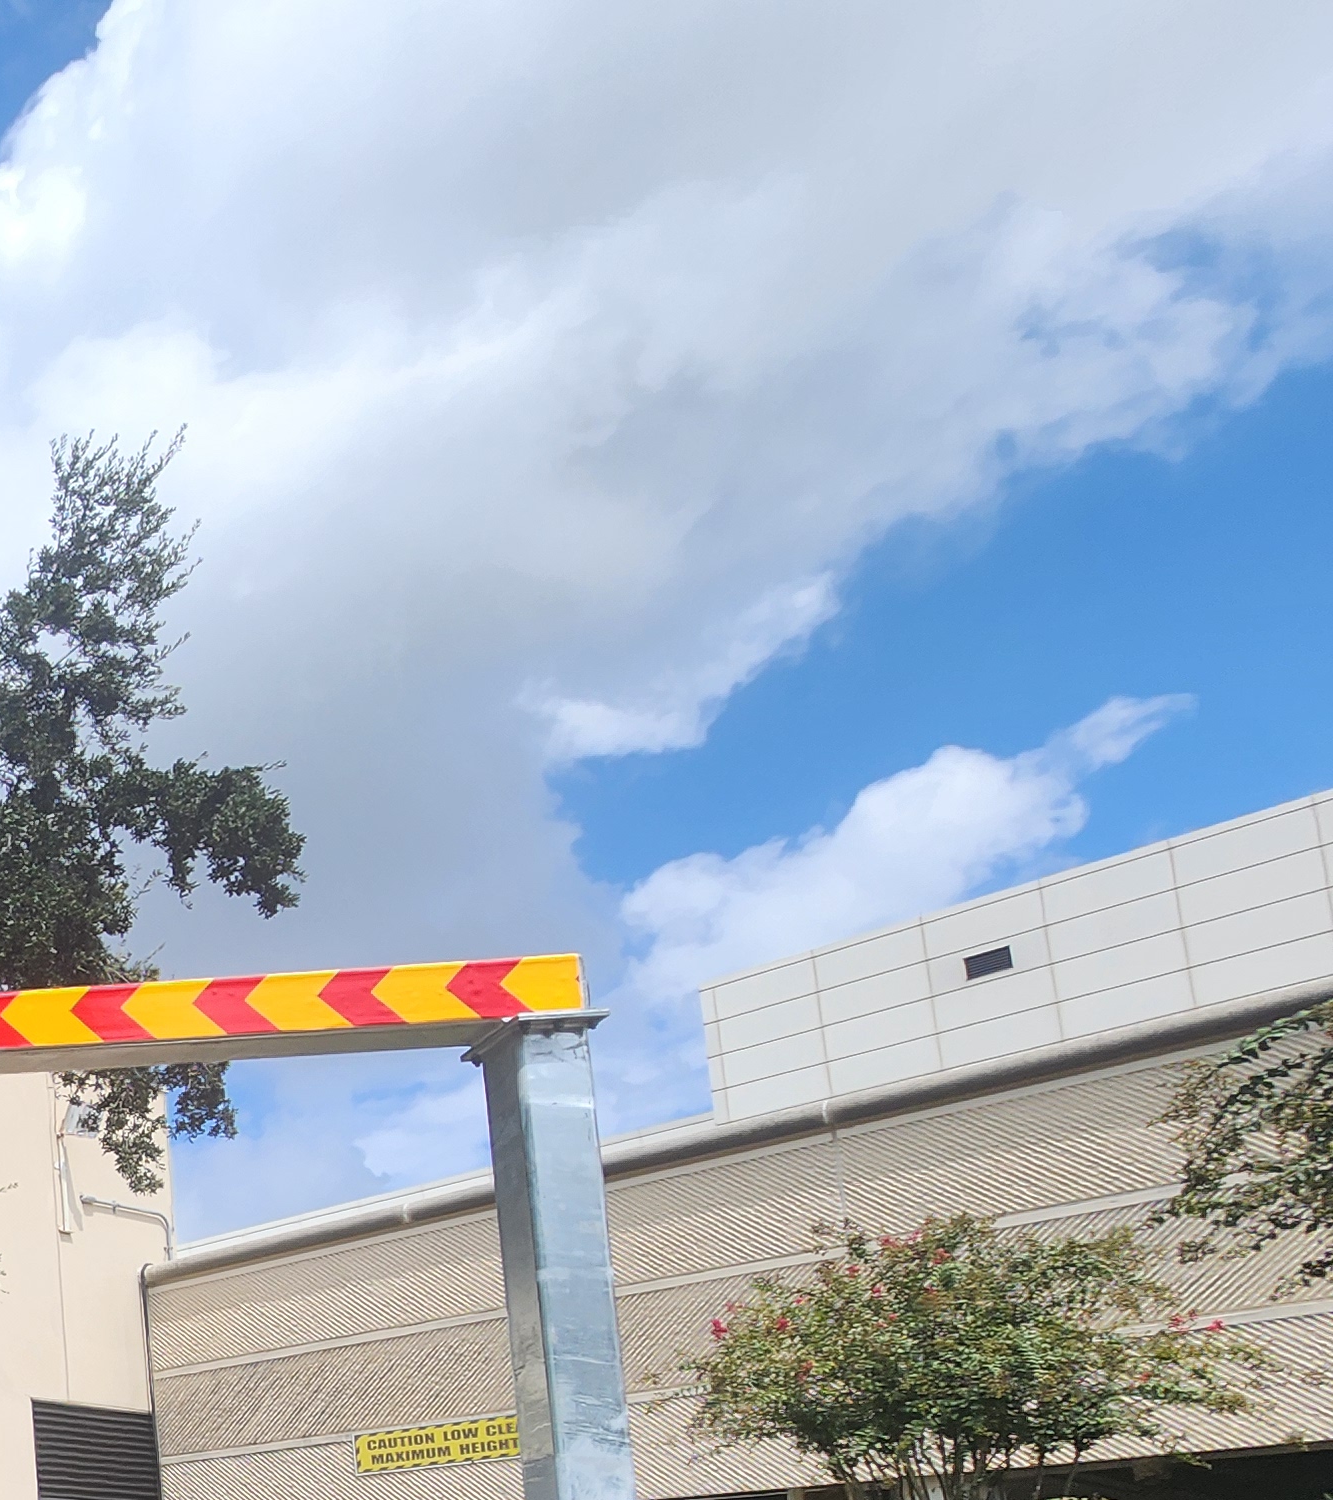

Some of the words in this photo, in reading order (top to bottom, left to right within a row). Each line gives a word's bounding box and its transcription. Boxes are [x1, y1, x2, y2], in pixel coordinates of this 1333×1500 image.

[367, 1433, 435, 1451] CAUTION
[443, 1427, 479, 1442] LOW
[485, 1421, 518, 1437] CLE
[371, 1445, 451, 1465] MAXIMUM
[459, 1437, 519, 1455] HEIGHT
